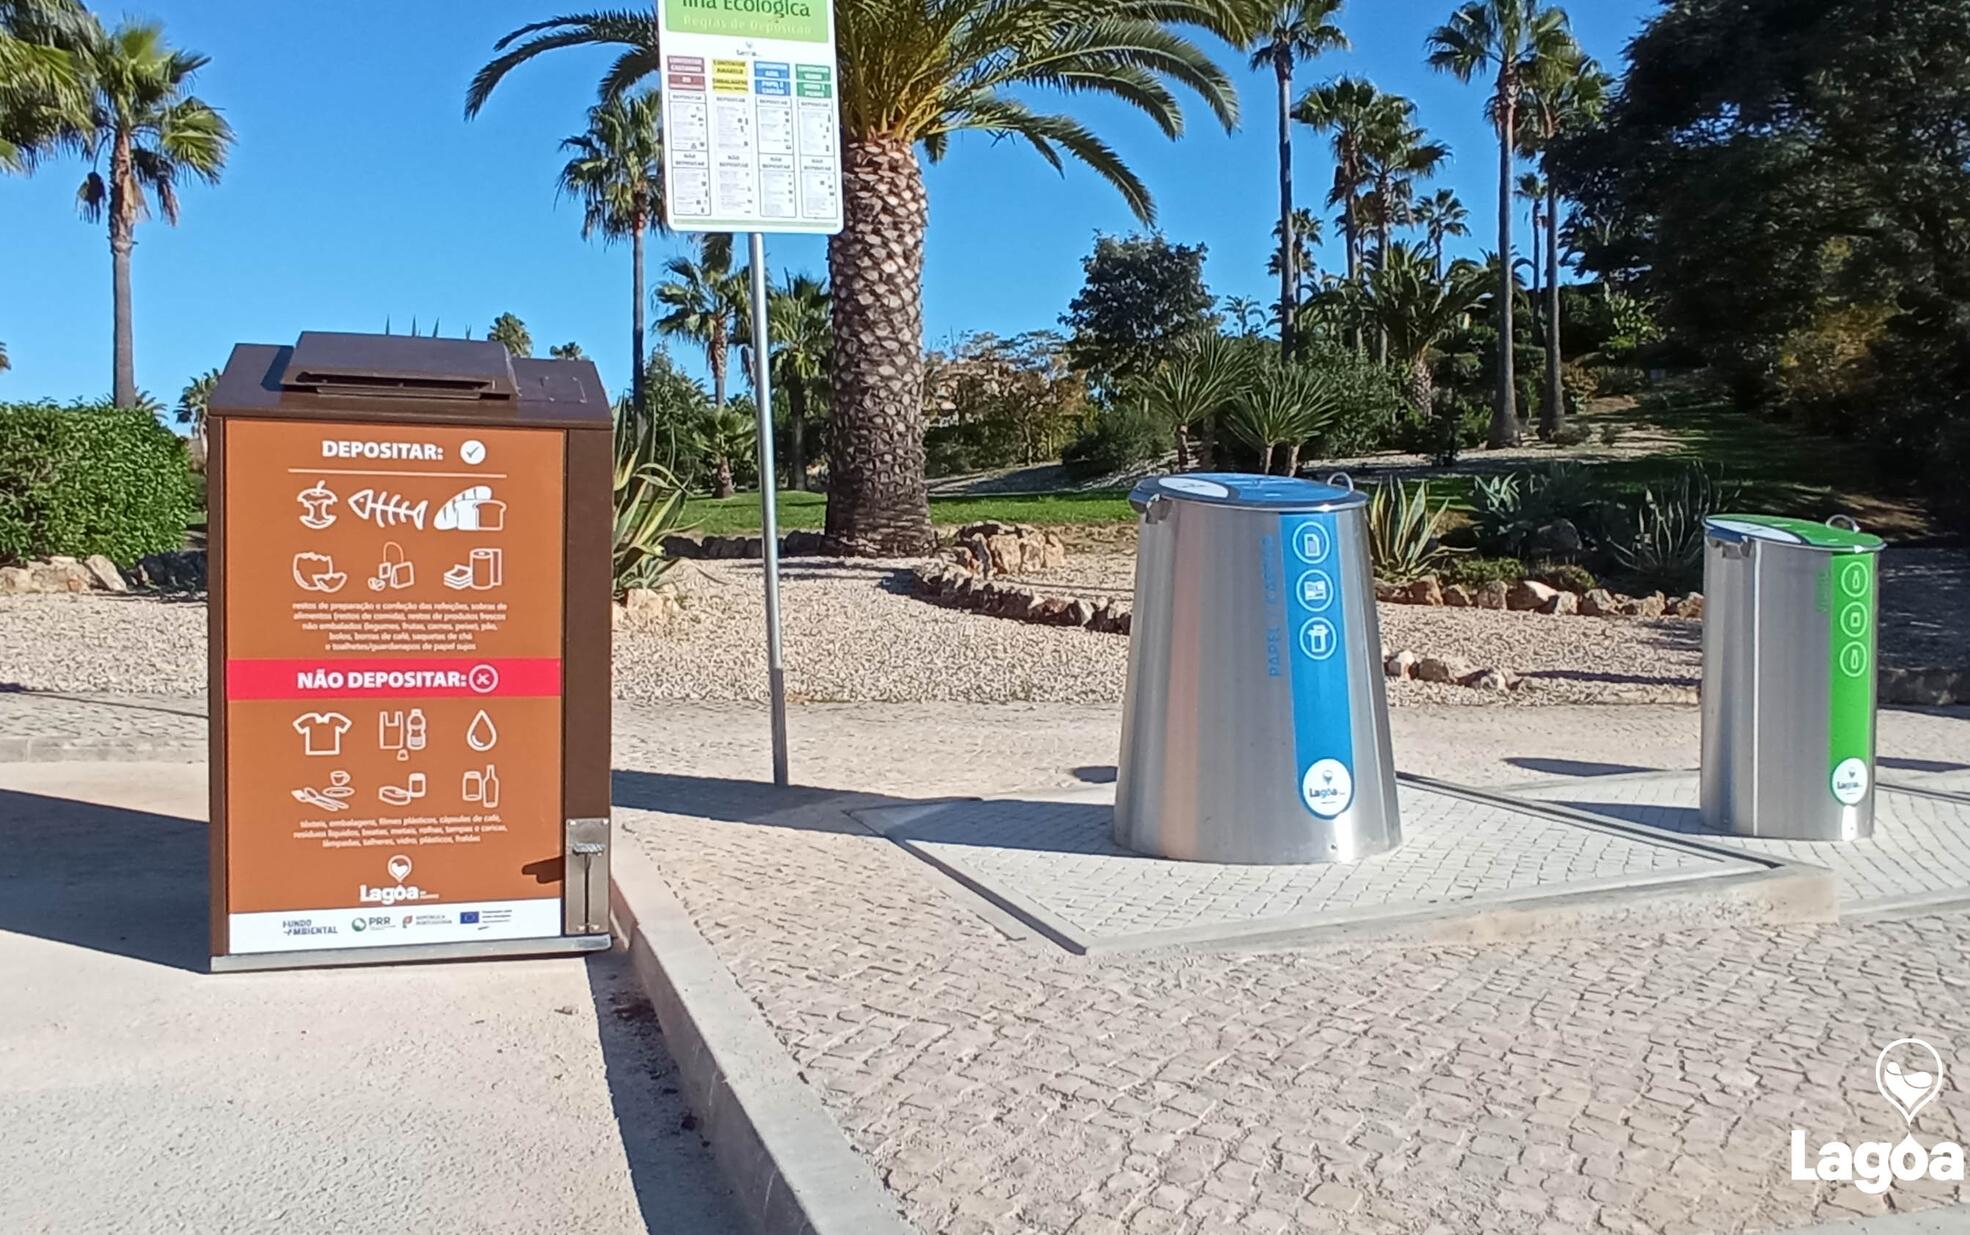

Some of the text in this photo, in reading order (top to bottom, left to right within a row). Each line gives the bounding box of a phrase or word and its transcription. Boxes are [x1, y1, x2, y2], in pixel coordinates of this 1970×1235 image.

[322, 440, 444, 460] DEPOSITAR:
[318, 602, 329, 610] de
[330, 602, 374, 611] preparação
[496, 602, 507, 610] de
[432, 612, 443, 620] de
[297, 669, 468, 689] NÃO DEPOSITAR:
[368, 916, 392, 926] PRR
